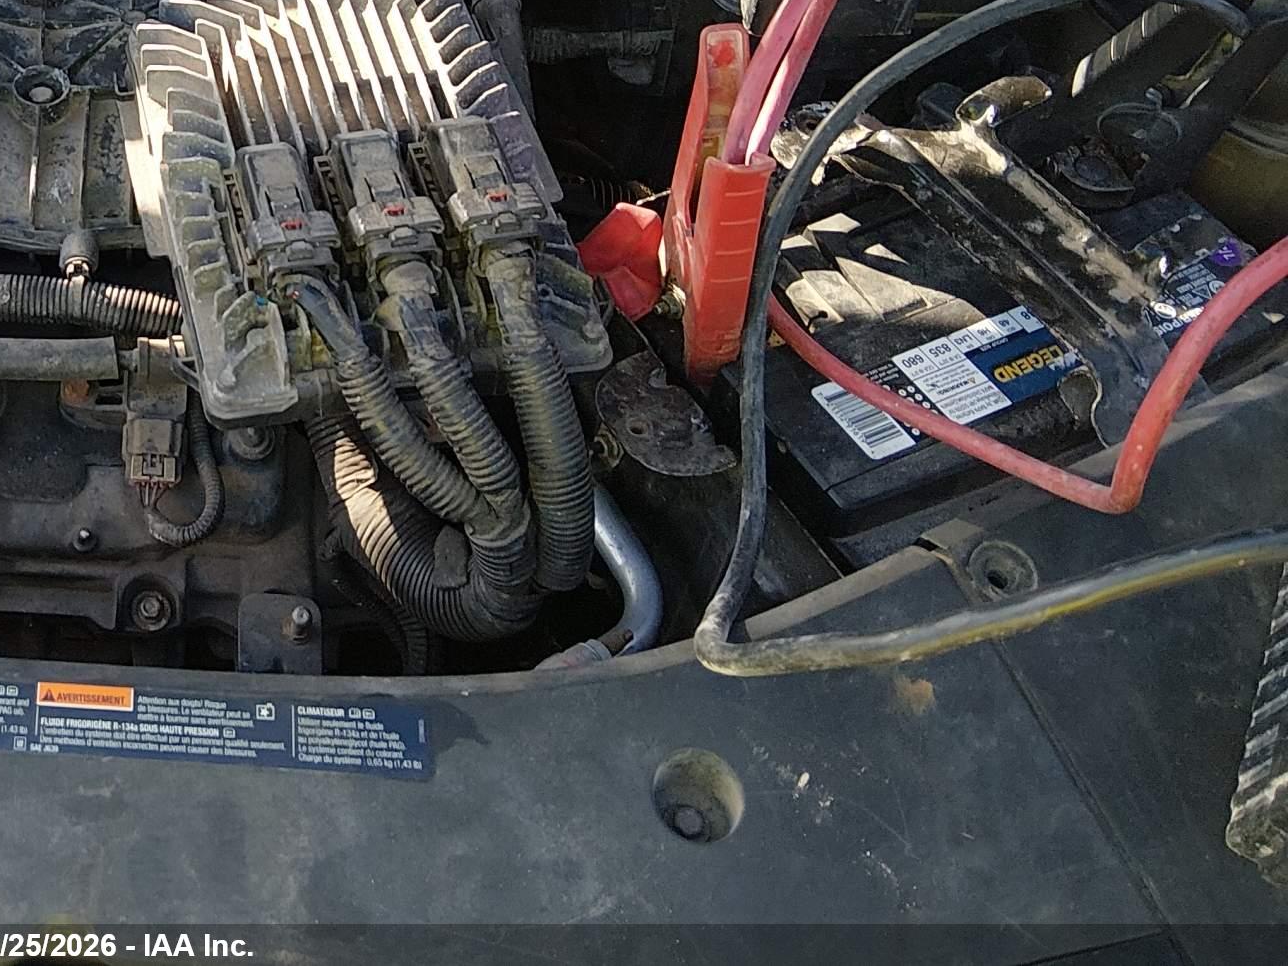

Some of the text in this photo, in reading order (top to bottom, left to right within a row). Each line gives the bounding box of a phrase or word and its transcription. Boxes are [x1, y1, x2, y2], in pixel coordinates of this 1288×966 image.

[929, 344, 952, 357] 835
[902, 355, 924, 368] 680
[994, 345, 1065, 383] LEGEND
[57, 693, 125, 705] AVERTISSEMENT
[298, 706, 345, 717] CLIMATISEUR
[41, 717, 65, 726] FLUIDE
[139, 724, 158, 732] SOUS
[160, 725, 183, 735] HAUTE
[183, 726, 219, 737] PRESSION
